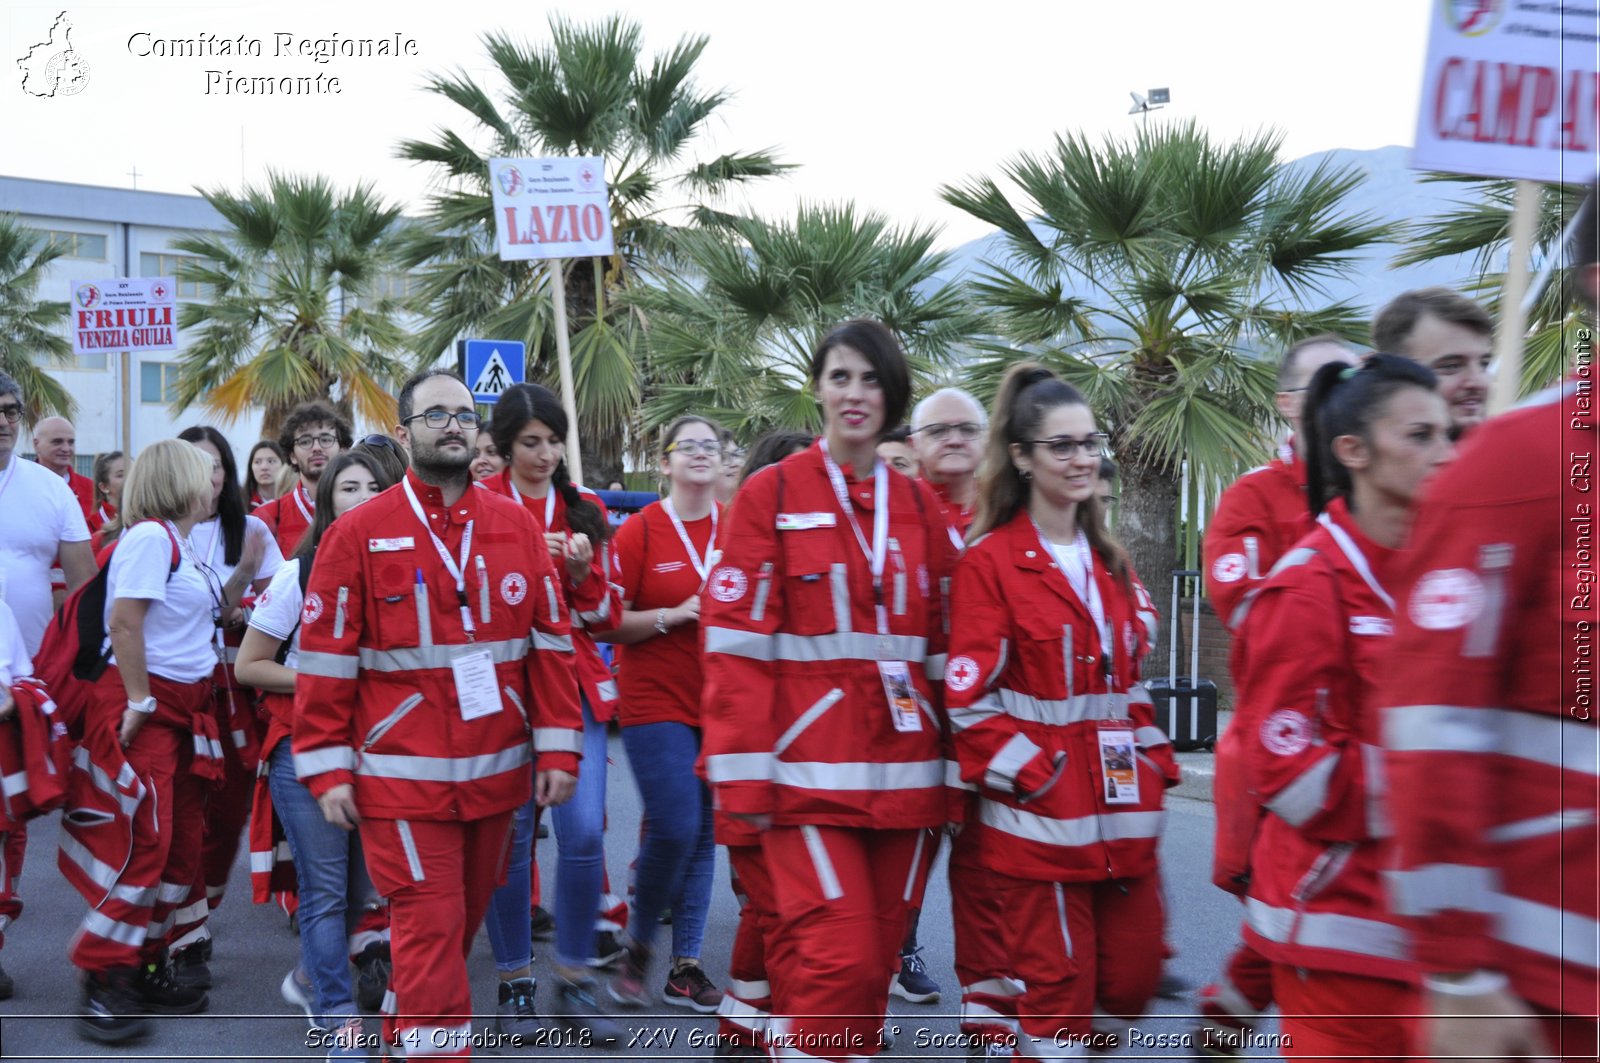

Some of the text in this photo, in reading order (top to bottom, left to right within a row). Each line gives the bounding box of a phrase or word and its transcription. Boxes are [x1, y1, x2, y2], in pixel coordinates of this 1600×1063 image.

[1431, 56, 1600, 152] CAMPA
[503, 203, 604, 245] LAZIO
[77, 307, 173, 329] FRIULI
[78, 327, 173, 349] VENEZIA GIULIA
